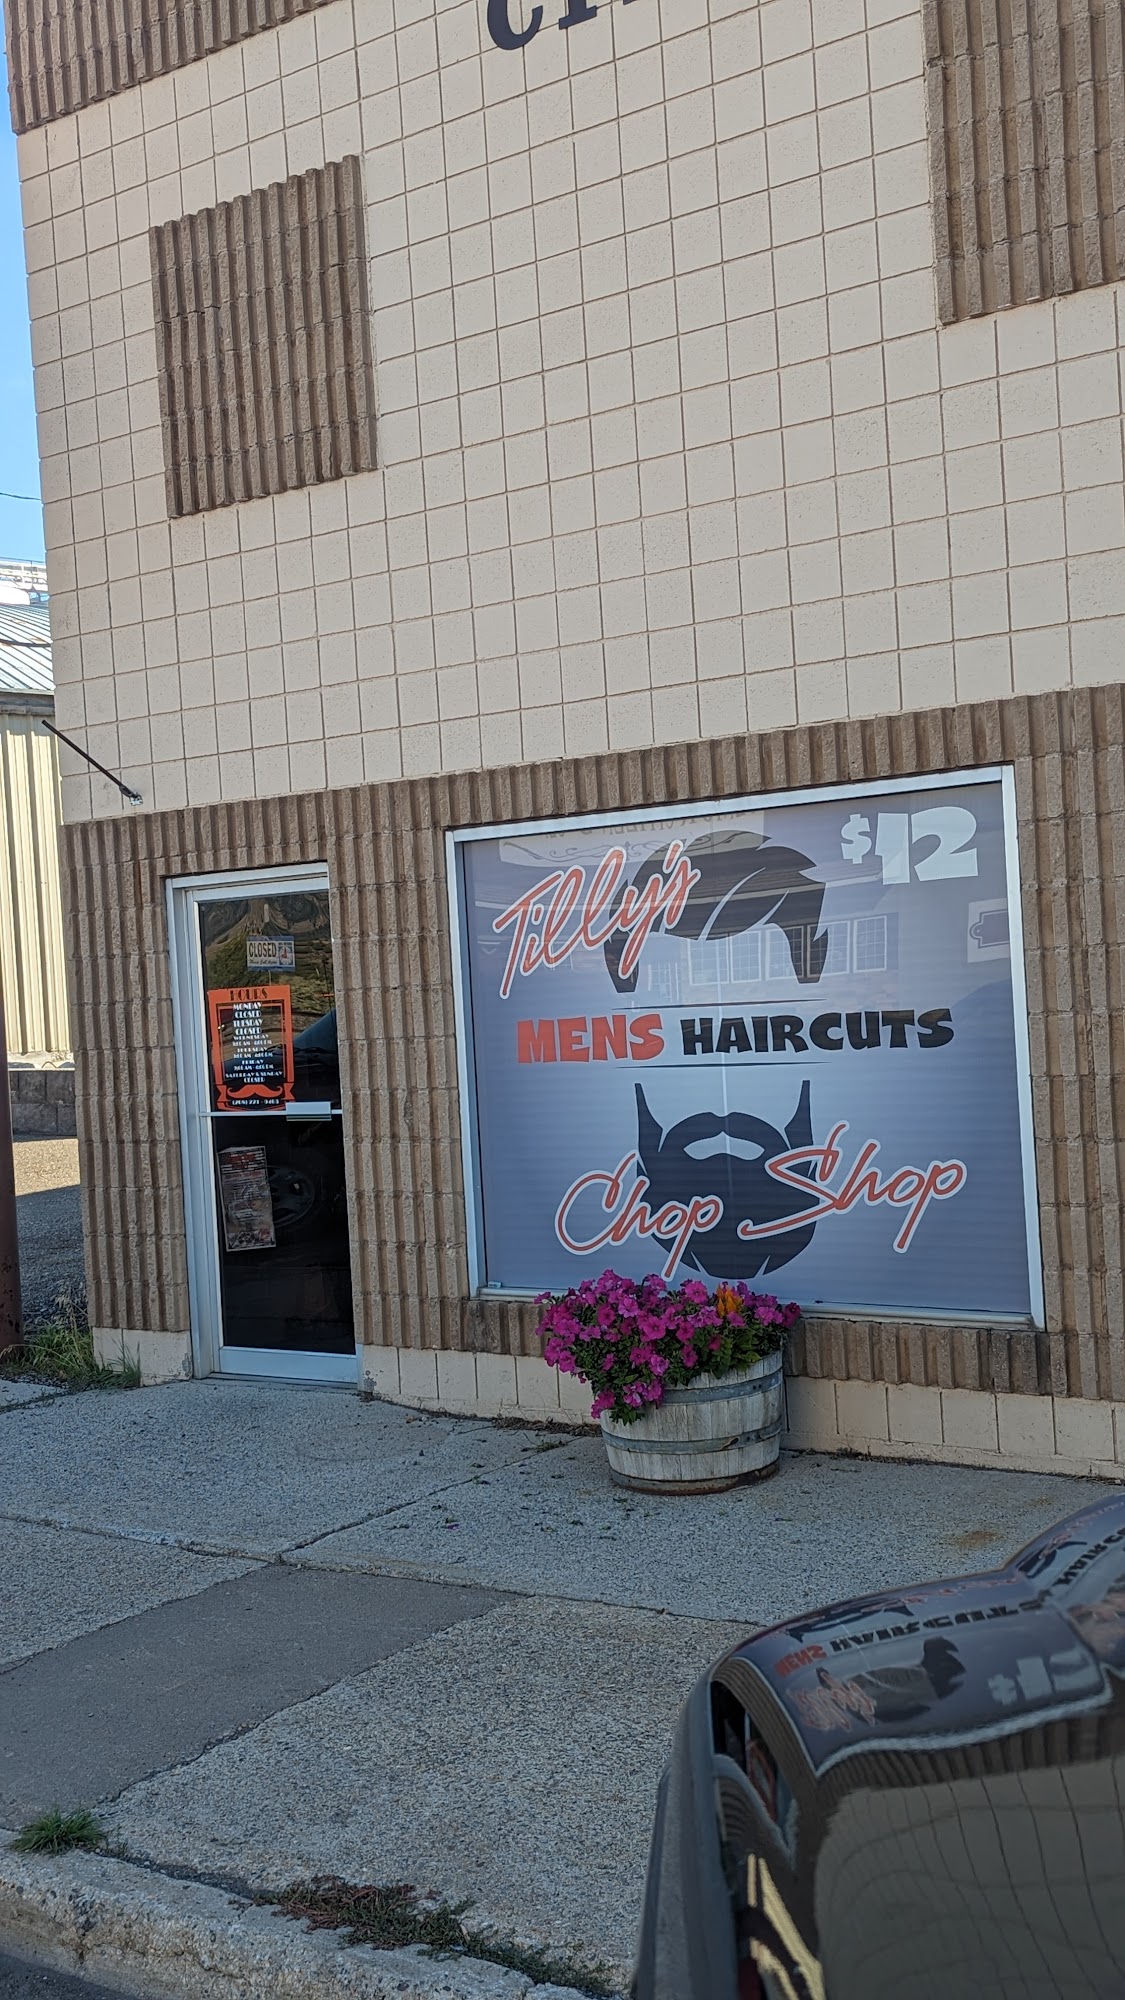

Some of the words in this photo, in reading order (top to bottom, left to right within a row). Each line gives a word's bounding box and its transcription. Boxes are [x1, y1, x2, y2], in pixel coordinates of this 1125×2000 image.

[841, 806, 978, 885] $12
[493, 840, 701, 999] Tilly's
[249, 942, 277, 958] CLOSED
[230, 988, 268, 1001] HOURS
[233, 1002, 263, 1010] MONDAY
[235, 1010, 262, 1019] CLOSED
[233, 1019, 264, 1027] TUESDAY
[235, 1027, 262, 1035] CLOSED
[517, 1014, 665, 1063] MENS
[681, 1008, 955, 1056] HAIRCUTS
[555, 1149, 724, 1281] Chop
[737, 1120, 968, 1253] Shop
